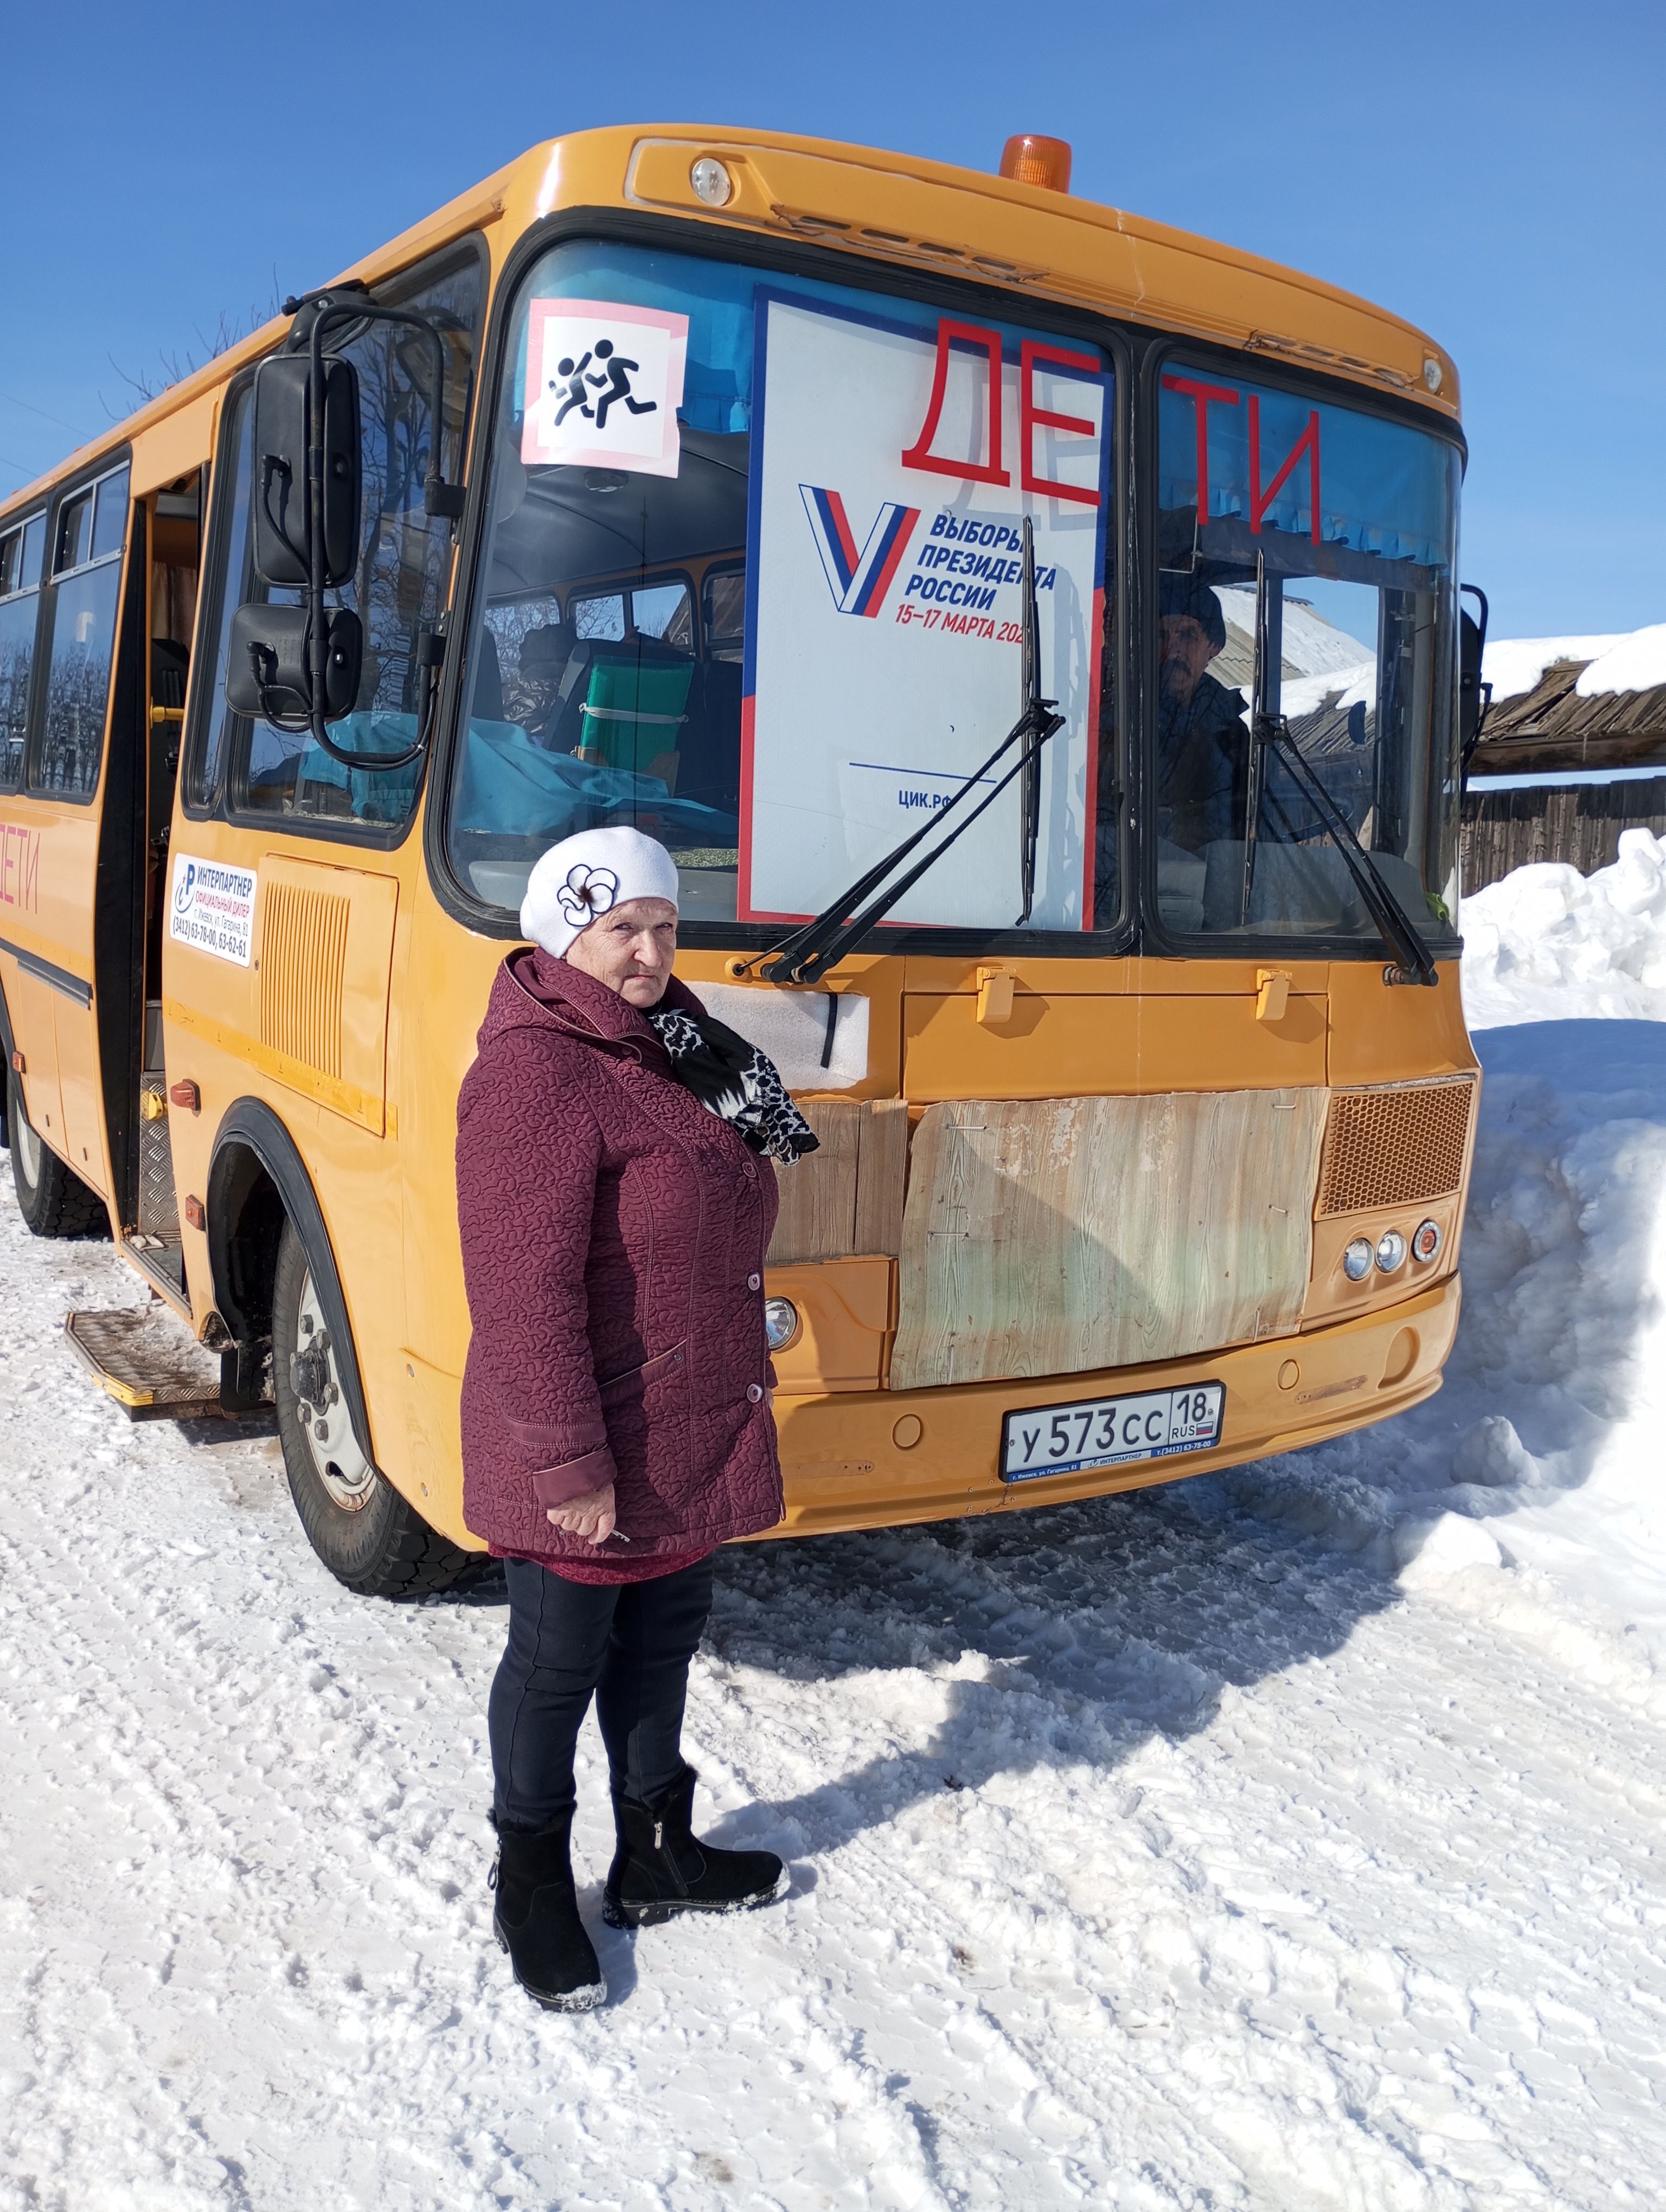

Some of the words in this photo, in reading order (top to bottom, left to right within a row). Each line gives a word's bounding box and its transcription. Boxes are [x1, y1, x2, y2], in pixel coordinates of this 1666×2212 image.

[904, 574, 997, 611] РОССИИ
[940, 612, 996, 639] МАРТА
[899, 790, 952, 809] ЦИК.РФ
[197, 866, 253, 898] ИНТЕРПАРТНЕР
[195, 890, 232, 914] ОФИЦИАЛЬНЫЙ
[232, 901, 250, 919] ДИЛЕР
[173, 915, 190, 941] (3412)
[191, 922, 217, 950] 63-78-00,
[219, 932, 246, 958] 63-62-61
[221, 915, 242, 937] Гагарина,
[242, 922, 248, 937] 81
[1176, 1392, 1207, 1425] 18
[1171, 1425, 1195, 1439] RUS
[1183, 1440, 1212, 1451] 63-78-00
[1100, 1453, 1142, 1465] ИНТЕРПАРТНЕР
